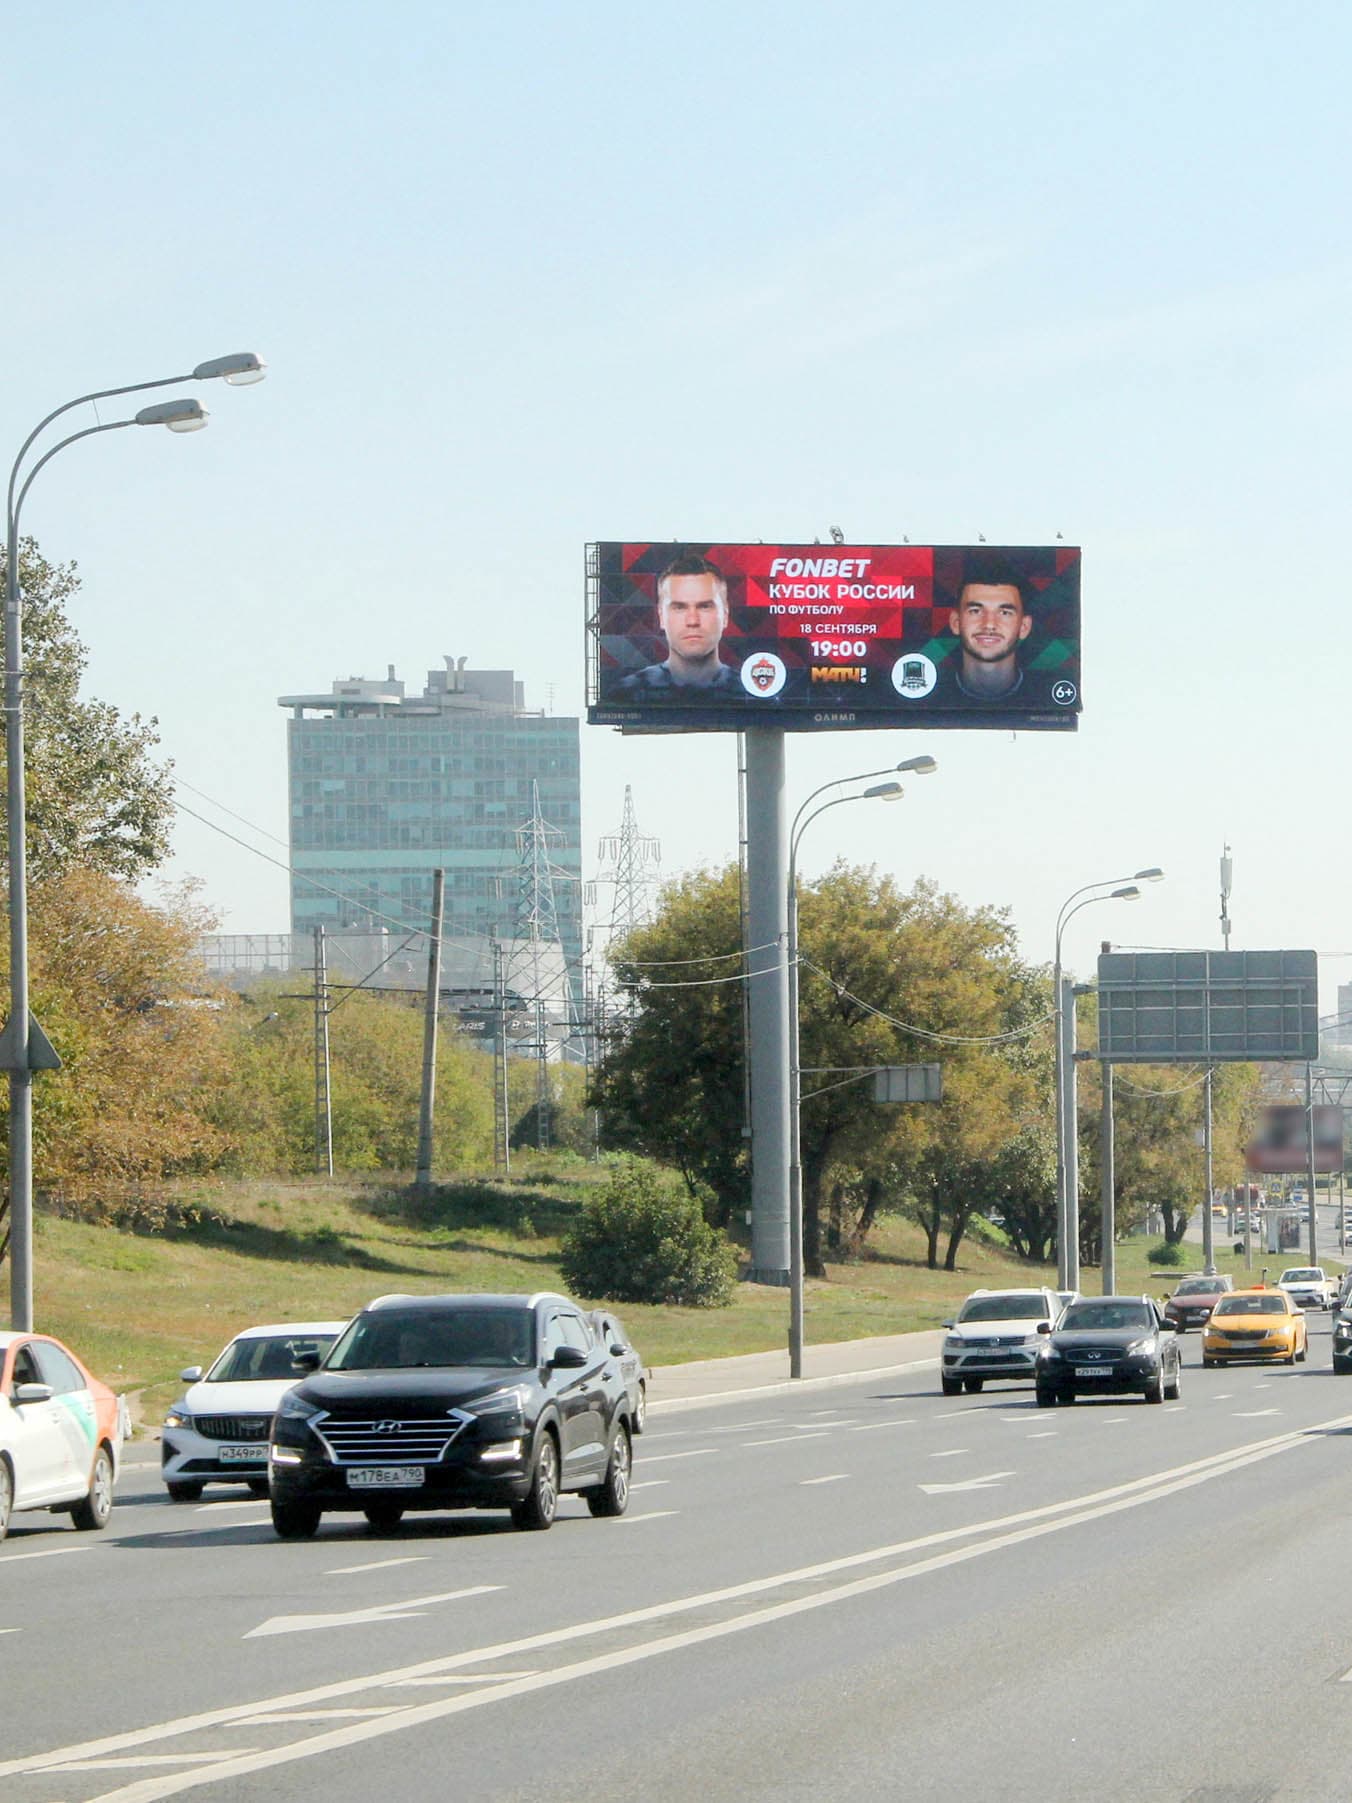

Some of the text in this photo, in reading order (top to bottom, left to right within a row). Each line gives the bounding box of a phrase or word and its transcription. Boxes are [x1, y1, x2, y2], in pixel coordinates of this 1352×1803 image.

[769, 558, 871, 578] FONBET
[769, 584, 915, 599] КУБОК РОССИИ
[769, 605, 844, 615] ПО ФУТБОЛУ
[800, 624, 877, 634] 18 СЕНТЯБРЯ
[811, 641, 867, 657] 19:00
[1055, 686, 1073, 698] 6+
[814, 713, 856, 722] ОЛИМП
[349, 1470, 400, 1482] М178ЕА
